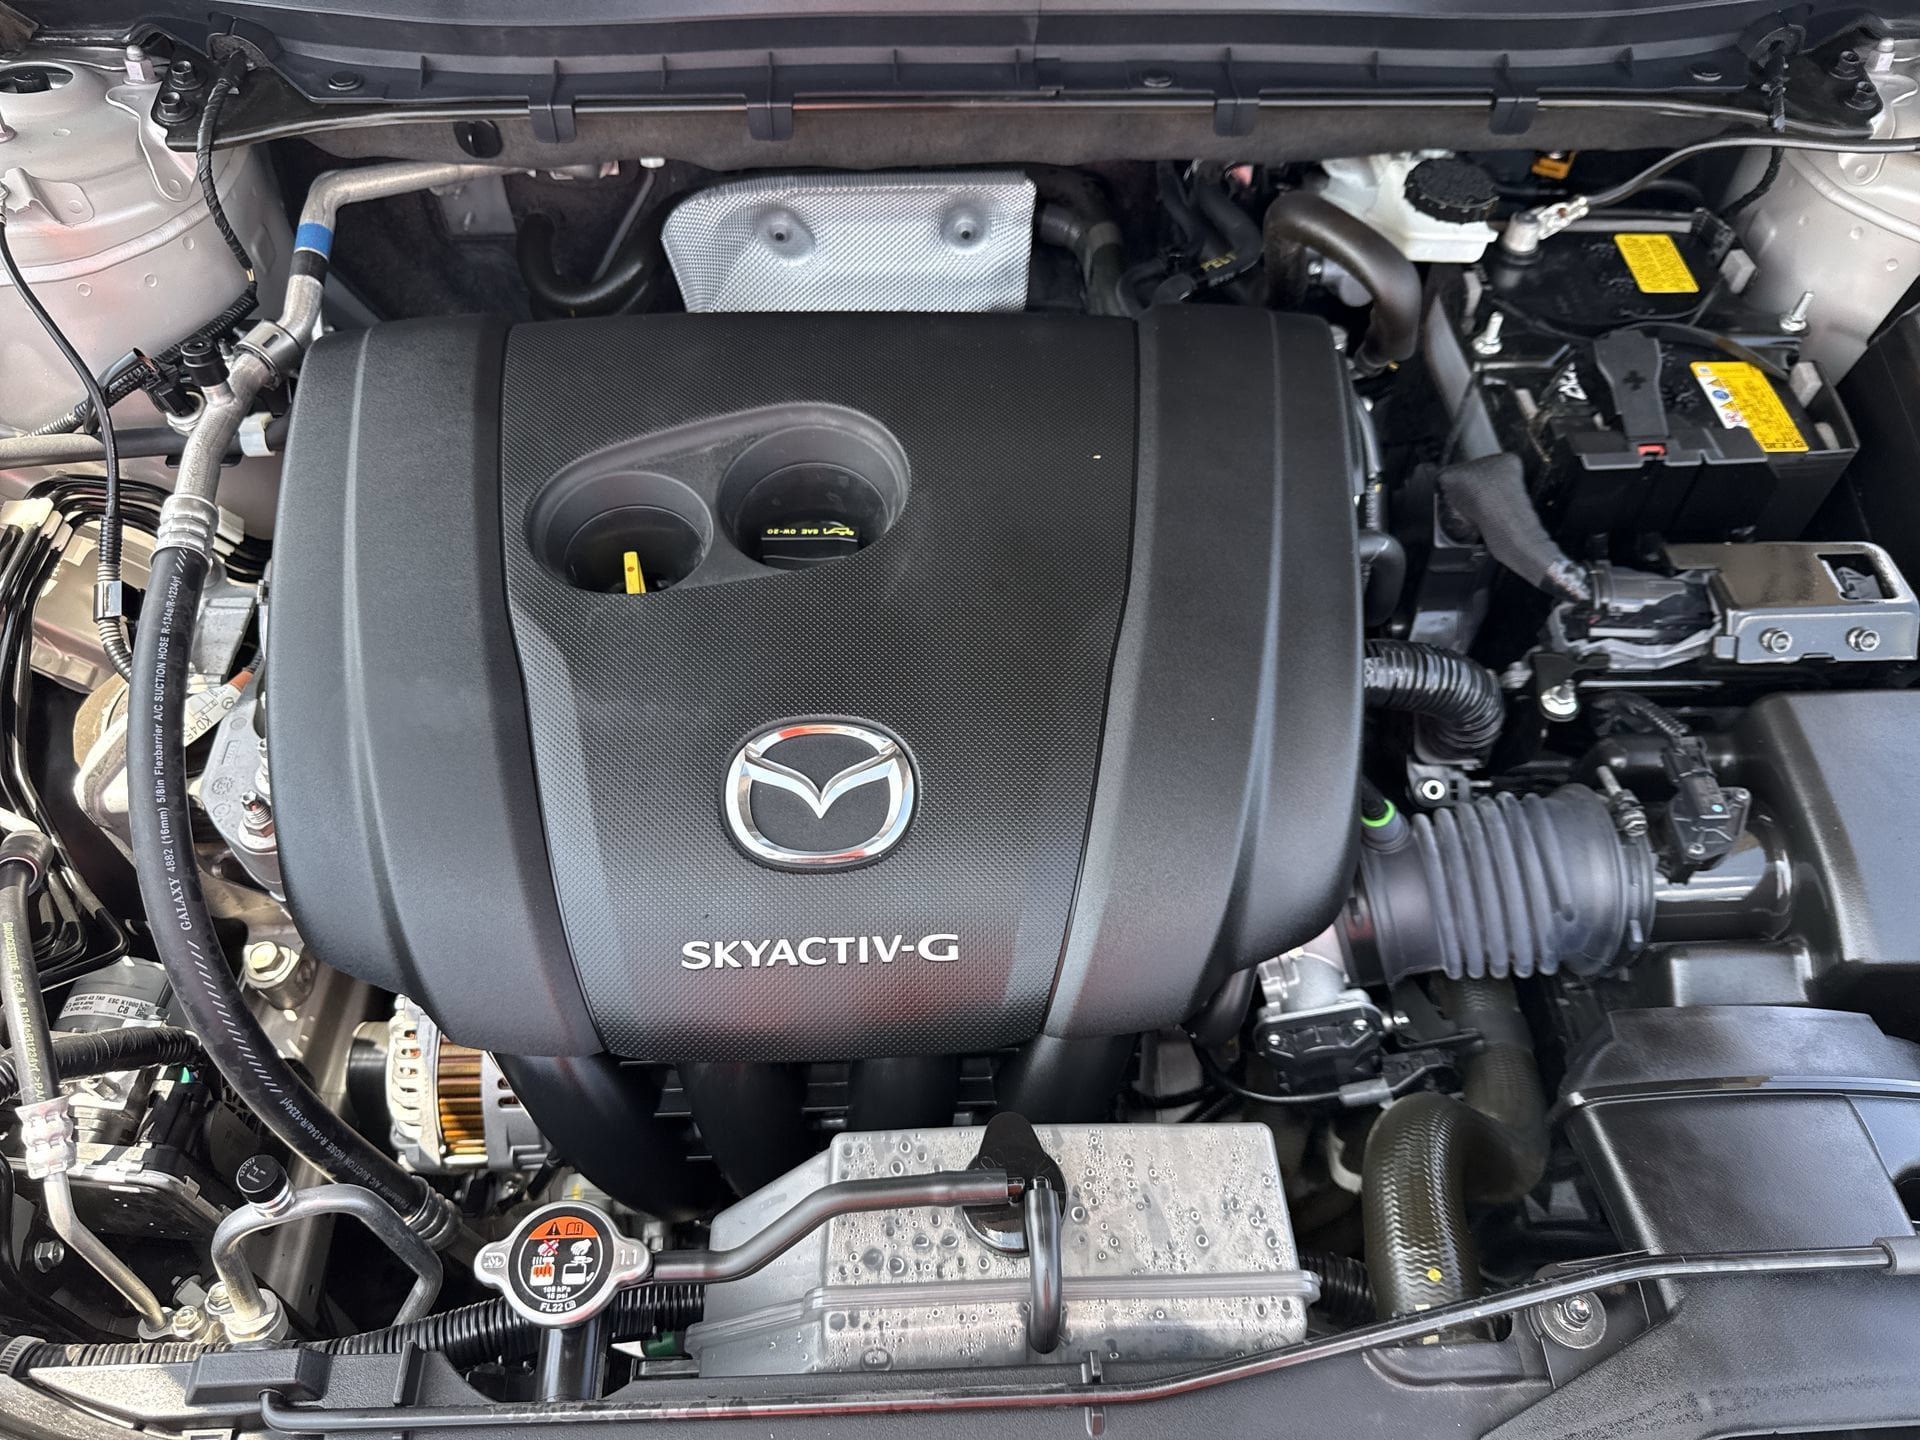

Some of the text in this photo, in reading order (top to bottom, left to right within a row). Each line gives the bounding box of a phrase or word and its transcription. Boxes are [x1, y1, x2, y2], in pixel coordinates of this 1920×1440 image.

[158, 636, 170, 660] HOSE
[154, 663, 167, 702] SUCTION
[153, 704, 164, 721] A/C
[153, 724, 164, 776] Flexbarrier
[155, 779, 166, 803] 5/8in
[157, 807, 174, 844] (16mm)
[163, 848, 176, 872] 4882
[168, 876, 192, 931] GALAXY
[681, 934, 959, 970] SKYACTIV-G
[325, 1142, 347, 1161] HOSE
[343, 1157, 372, 1181] SUCTION
[620, 1249, 638, 1265] 1.1
[540, 1302, 564, 1312] FL22
[556, 1292, 568, 1300] psi
